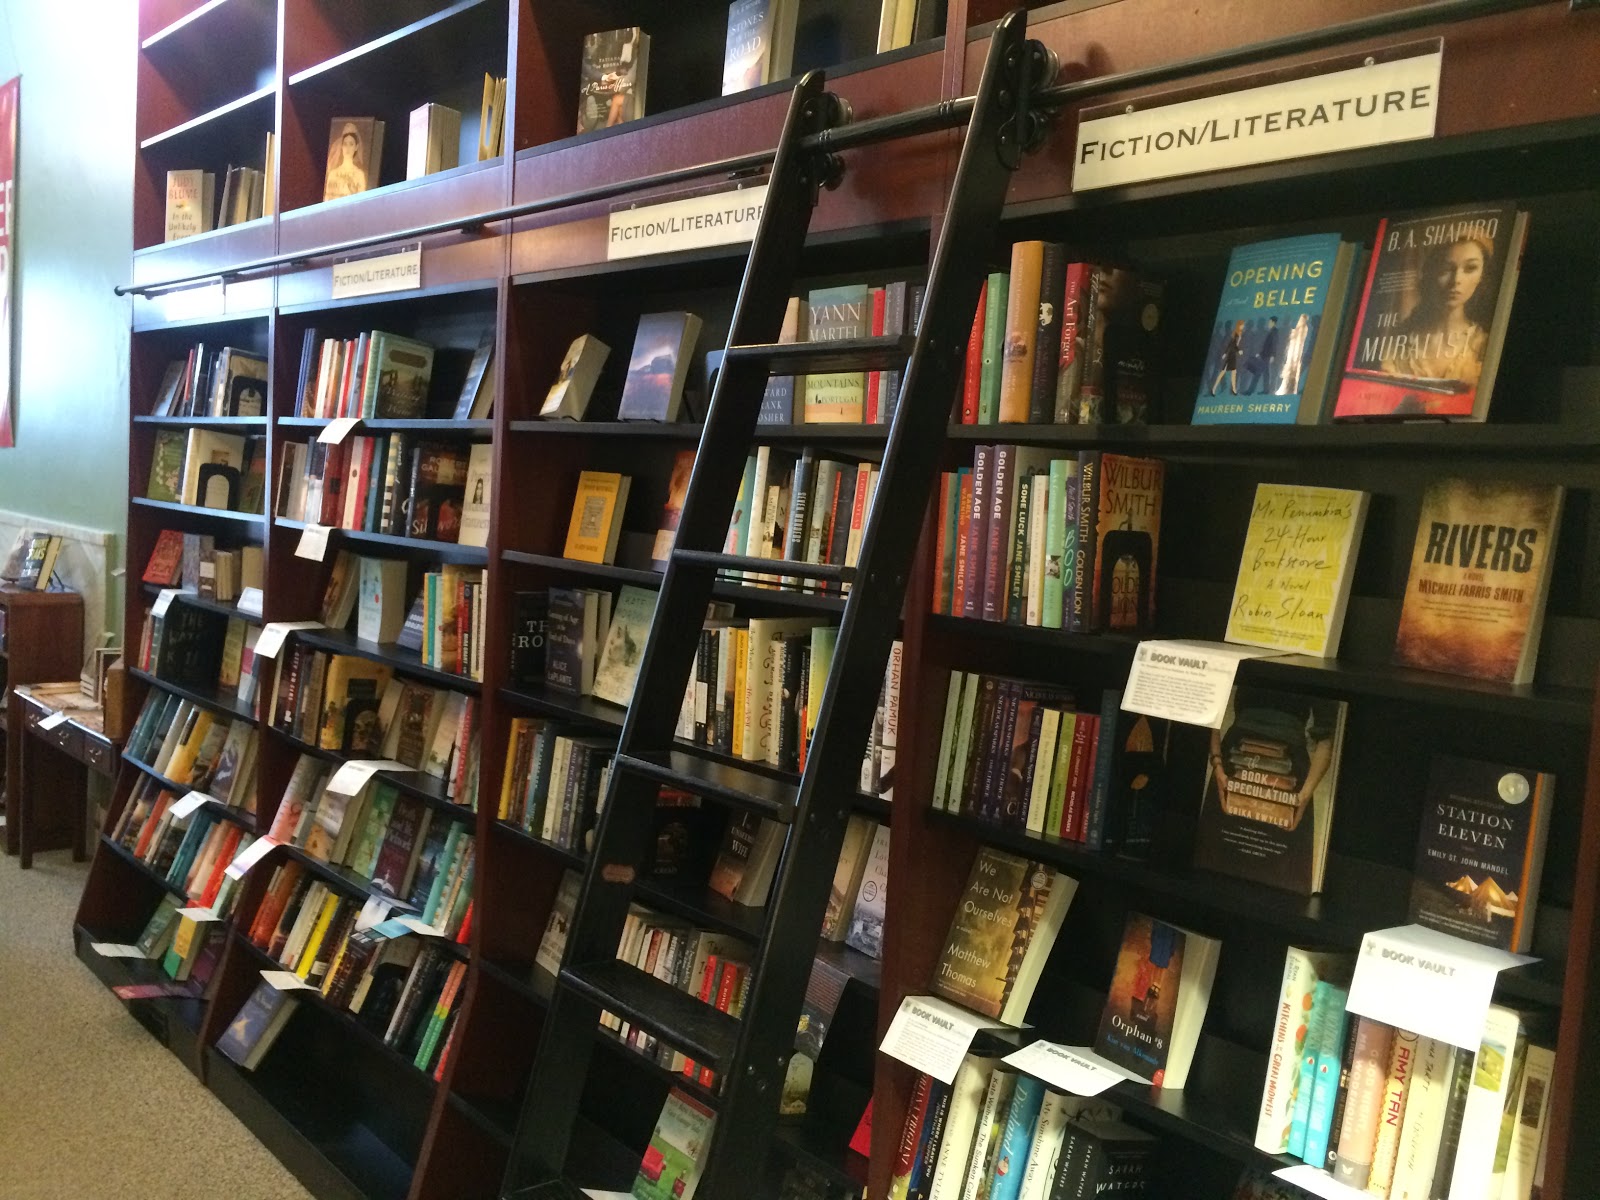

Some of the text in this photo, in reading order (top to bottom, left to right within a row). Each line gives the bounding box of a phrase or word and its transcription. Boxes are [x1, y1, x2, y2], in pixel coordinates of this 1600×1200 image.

[729, 36, 762, 62] ROAD
[1079, 84, 1431, 165] FICTION/LITERATURE
[168, 188, 199, 201] BLUME
[169, 222, 197, 234] Unlikely
[1388, 230, 1406, 252] B.
[1406, 228, 1421, 250] A.
[1424, 217, 1500, 247] SHAPIRO
[333, 263, 419, 287] FICTION/LITERATURE
[1230, 260, 1323, 288] OPENING
[1253, 287, 1317, 308] BELLE
[809, 302, 861, 325] YANN
[1377, 311, 1398, 329] THE
[1062, 297, 1077, 361] Art Forger
[1361, 327, 1473, 364] MURALIST
[806, 378, 860, 390] MOUNTAINS
[1197, 403, 1292, 416] MAUREEN SHERRY
[1104, 462, 1161, 491] WILBUR
[853, 472, 866, 529] CLOUD ATLAS
[1105, 490, 1156, 517] SMITH
[1281, 500, 1353, 519] Penumbra's
[792, 492, 807, 543] SEVEN WONDERS
[967, 452, 986, 593] GOLDEN AGE JANE SMILEY
[987, 451, 1007, 594] GOLDEN AGE JANE SMILEY
[1012, 483, 1029, 598] SOME LUCK JANE SMILEY
[1074, 463, 1094, 614] WILBUR SMITH GOLDEN LION
[1263, 527, 1326, 546] 24-Hour
[1423, 520, 1538, 574] RIVERS
[1252, 548, 1332, 571] Bookstore
[956, 558, 965, 591] SMILEY
[1266, 580, 1310, 591] A Novel
[1418, 578, 1524, 603] MICHAEL FARRIS SMITH
[1234, 597, 1325, 620] Robin Sloan
[553, 660, 567, 671] ALICE
[1150, 652, 1208, 670] BOOK VAULT
[887, 647, 902, 735] ORHAN PAMUK
[984, 695, 1005, 797] NICHOLAS SPARKS CHOICE
[997, 696, 1016, 800] NICHOLAS SPARKS CHOICE
[1241, 769, 1268, 786] BOOK
[1067, 791, 1077, 813] NICHOLAS
[1227, 780, 1298, 806] SPECULATION
[1228, 805, 1253, 820] ERIKA
[1436, 803, 1515, 831] STATION
[1438, 823, 1507, 850] ELEVEN
[979, 859, 997, 876] We
[1427, 848, 1510, 876] EMILY ST. JOHN MANDEL
[969, 881, 1014, 905] Are Not
[963, 900, 1013, 928] Ourselves
[947, 943, 992, 970] Matthew
[1381, 947, 1456, 978] BOOK VAULT
[940, 963, 977, 988] Thomas
[1291, 965, 1299, 982] RYAN
[911, 1006, 955, 1031] BOOK VAULT
[1111, 1015, 1164, 1050] Orphan #8
[1276, 1002, 1292, 1043] KITCHENS
[1046, 1047, 1098, 1071] BOOK VAULT
[1362, 1049, 1378, 1087] GOOD
[1386, 1047, 1411, 1127] AMY TAN
[1423, 1060, 1434, 1093] TARTT
[1264, 1079, 1278, 1118] MIDWEST
[1342, 1060, 1362, 1141] WODEHOUSE
[923, 1102, 941, 1166] JONATHAN TROPPER
[934, 1117, 944, 1140] WHERE
[969, 1077, 1000, 1180] Kate Walbert The Sunken
[1003, 1085, 1029, 1155] Dietland
[901, 1114, 919, 1165] TRIGIANI
[928, 1143, 937, 1163] LEAVE
[1026, 1101, 1054, 1184] My Sunshine Away
[940, 1142, 952, 1167] ANNE
[1059, 1135, 1076, 1189] SARAH WATERS
[925, 1164, 933, 1178] YOU
[1076, 1144, 1094, 1198] SARAH WATERS
[933, 1172, 945, 1200] TYLER
